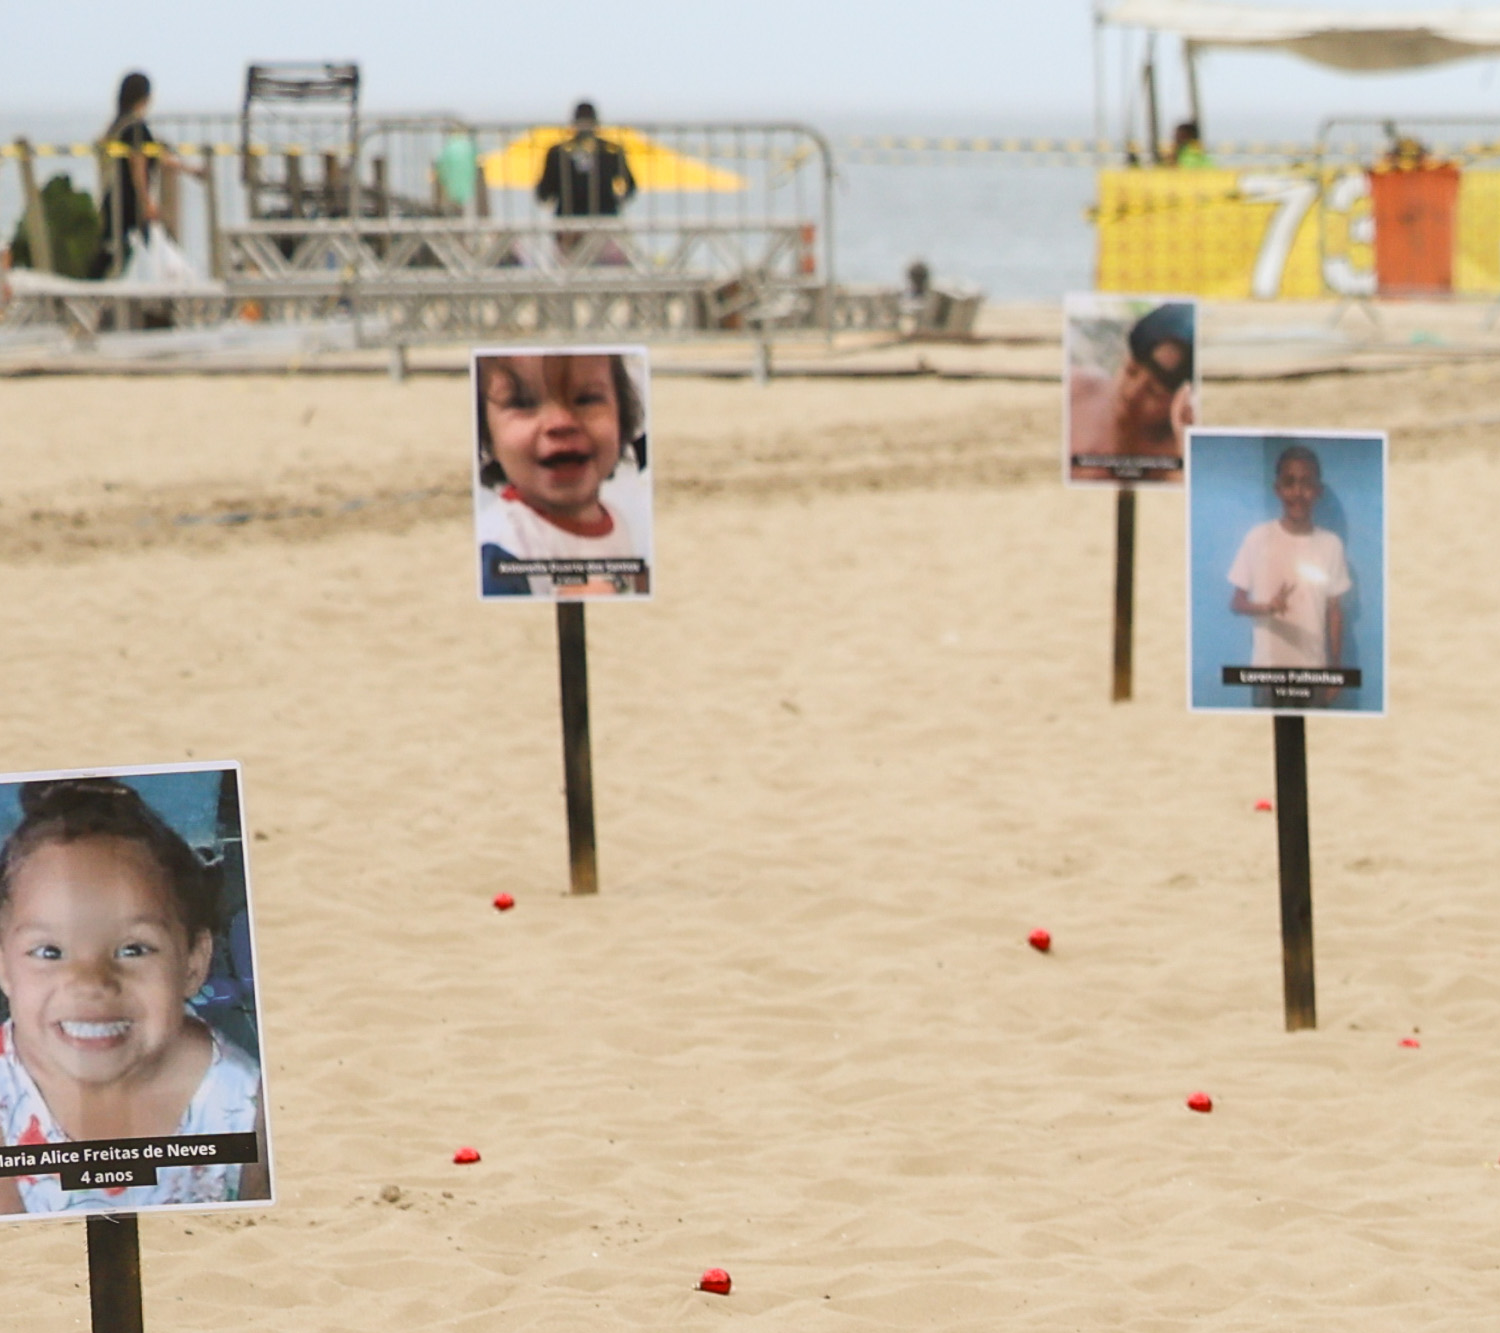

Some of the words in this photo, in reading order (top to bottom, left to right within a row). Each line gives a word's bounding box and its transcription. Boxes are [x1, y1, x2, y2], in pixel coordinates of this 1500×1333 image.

[40, 1147, 80, 1165] Alice
[83, 1144, 140, 1162] Freitas
[144, 1143, 164, 1159] de
[167, 1142, 217, 1158] Neves
[80, 1170, 91, 1185] 4
[94, 1169, 134, 1185] anos
